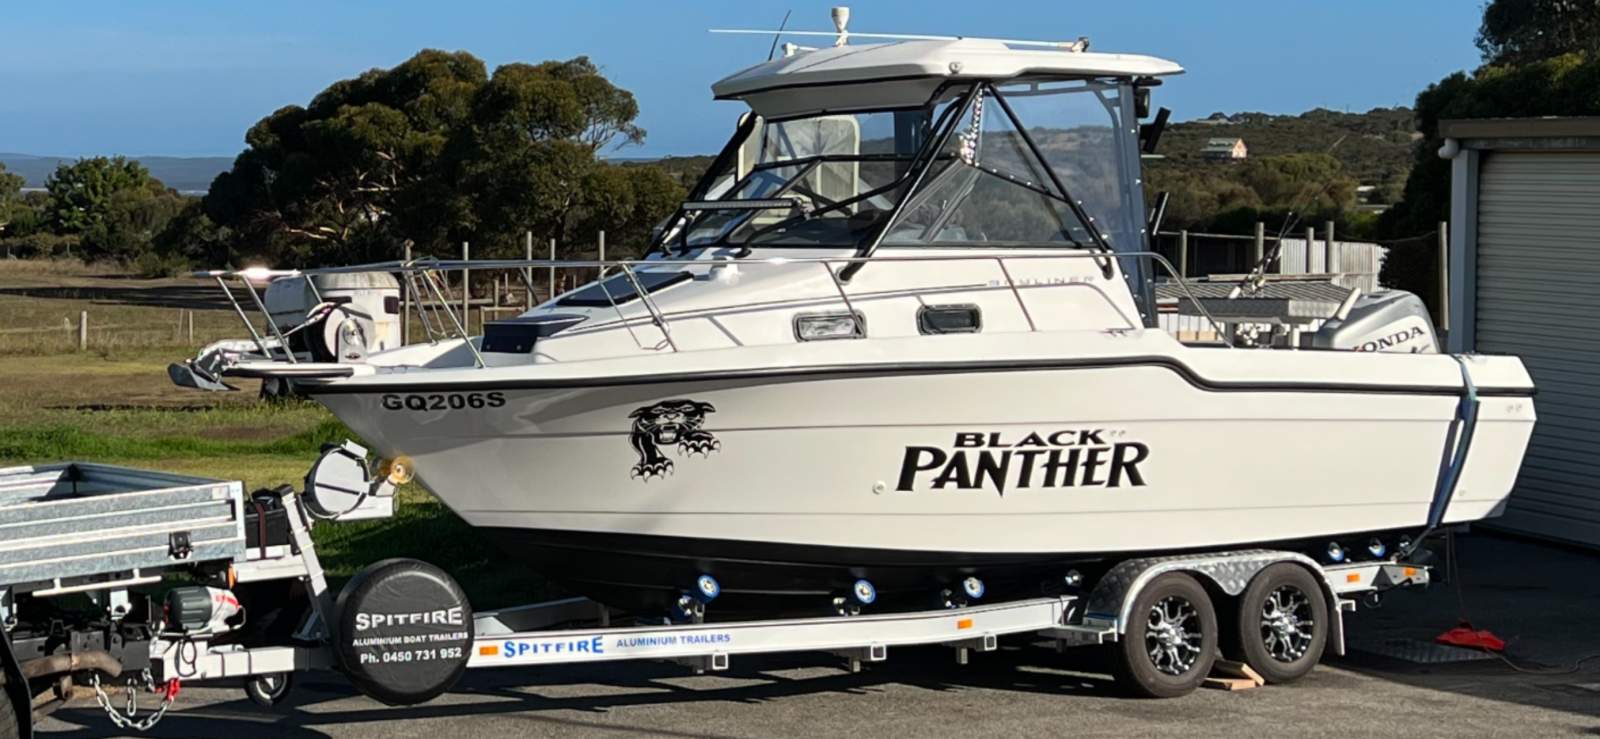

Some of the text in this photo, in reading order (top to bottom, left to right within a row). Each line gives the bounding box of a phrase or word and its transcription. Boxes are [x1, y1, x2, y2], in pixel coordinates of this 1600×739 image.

[382, 391, 506, 411] GQ206S
[954, 429, 1107, 448] BLACK
[895, 442, 1150, 497] PANTHER
[355, 606, 463, 631] SPITFIRE
[352, 631, 469, 647] ALUMINIUM BOAT TRAILERS
[504, 633, 731, 658] SPITFIRE ALUMINIUM TRAILERS
[360, 647, 462, 664] Ph. 0450 731 952
